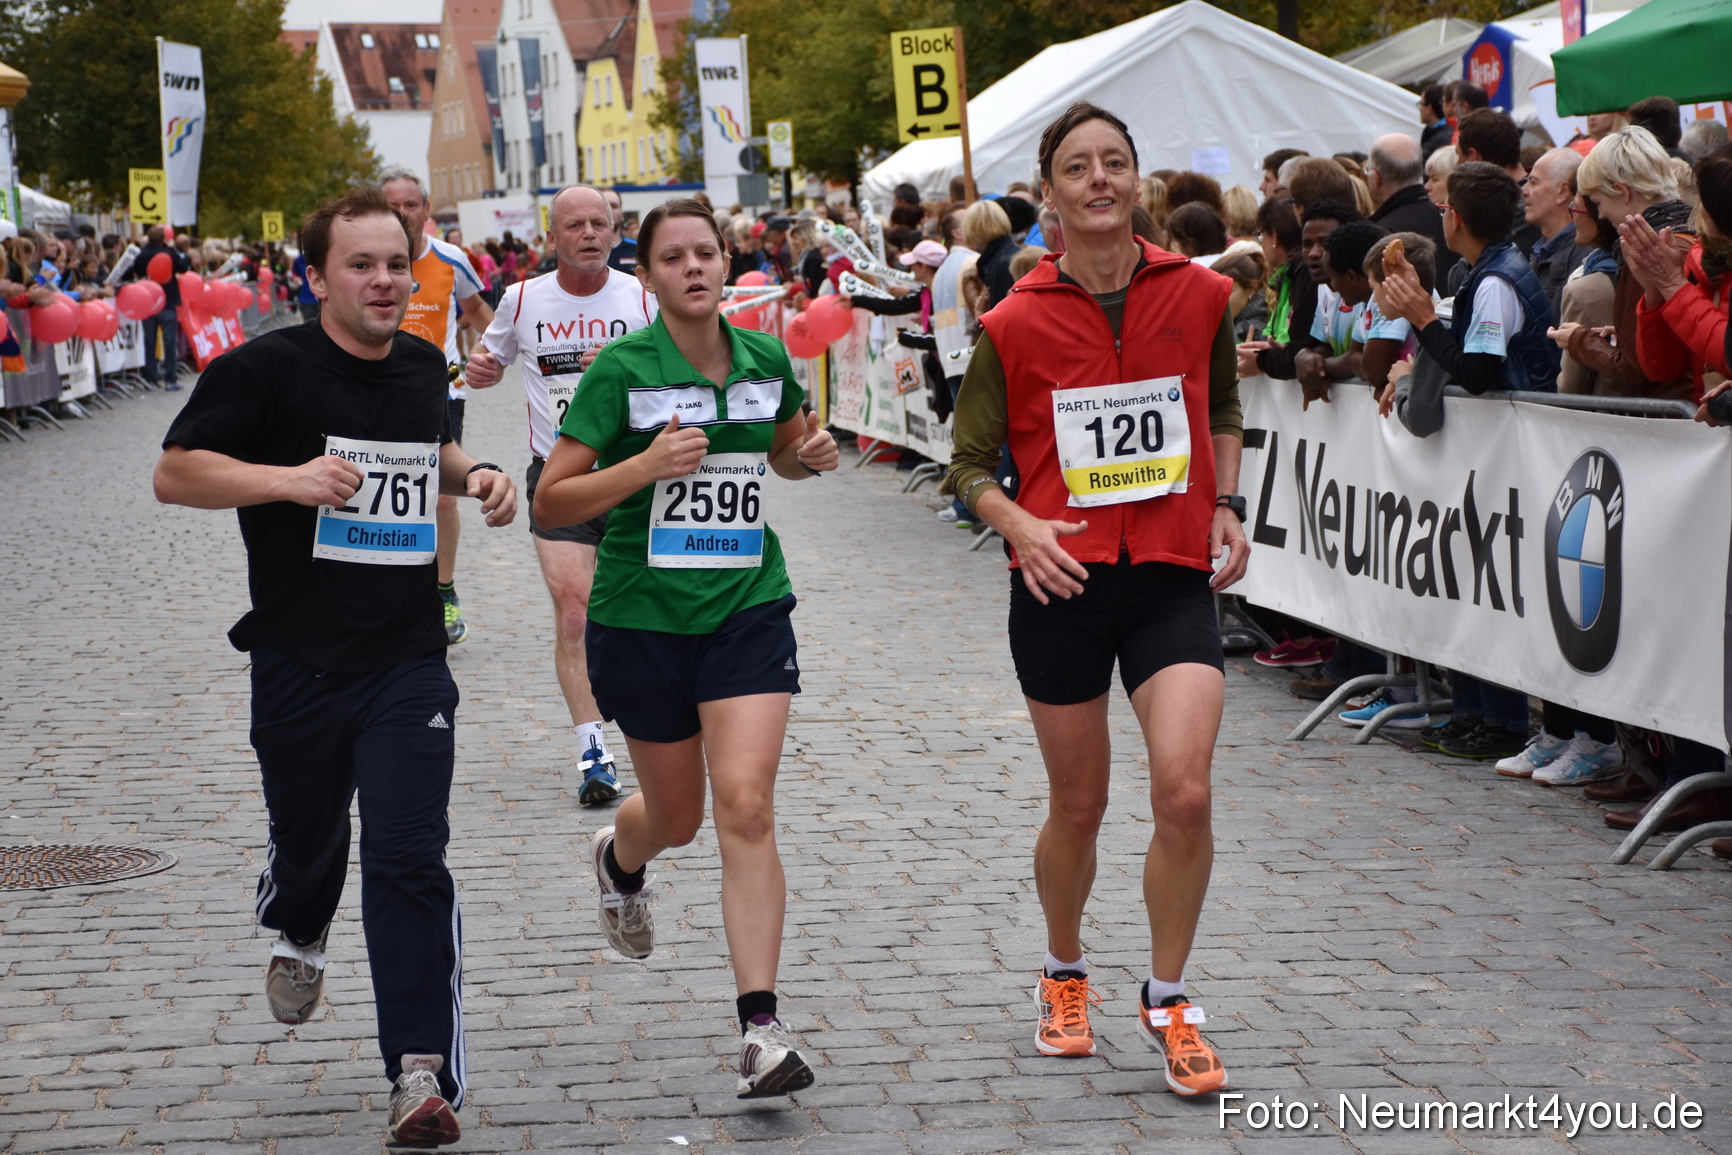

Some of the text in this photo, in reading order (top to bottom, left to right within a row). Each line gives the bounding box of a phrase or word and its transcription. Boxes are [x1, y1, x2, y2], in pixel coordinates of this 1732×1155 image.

[901, 34, 955, 55] Block
[163, 72, 200, 91] swn
[912, 63, 949, 116] B
[133, 171, 162, 182] Block
[139, 186, 157, 211] C
[268, 222, 278, 234] D
[535, 313, 627, 343] twinn
[537, 343, 578, 354] Consulting
[580, 341, 586, 349] &
[545, 354, 575, 364] TWINN
[549, 387, 573, 395] PARTL
[685, 401, 703, 409] JAKO
[1057, 391, 1163, 413] PARTL Neumarkt
[1085, 410, 1164, 459] 120
[329, 448, 426, 466] PARTL Neumarkt
[699, 464, 755, 475] Neumarkt
[1089, 466, 1167, 489] Roswitha
[664, 481, 760, 523] 2596
[1555, 455, 1624, 531] BMW
[347, 526, 417, 547] Christian
[1295, 438, 1524, 618] Neumarkt
[685, 535, 739, 551] Andrea
